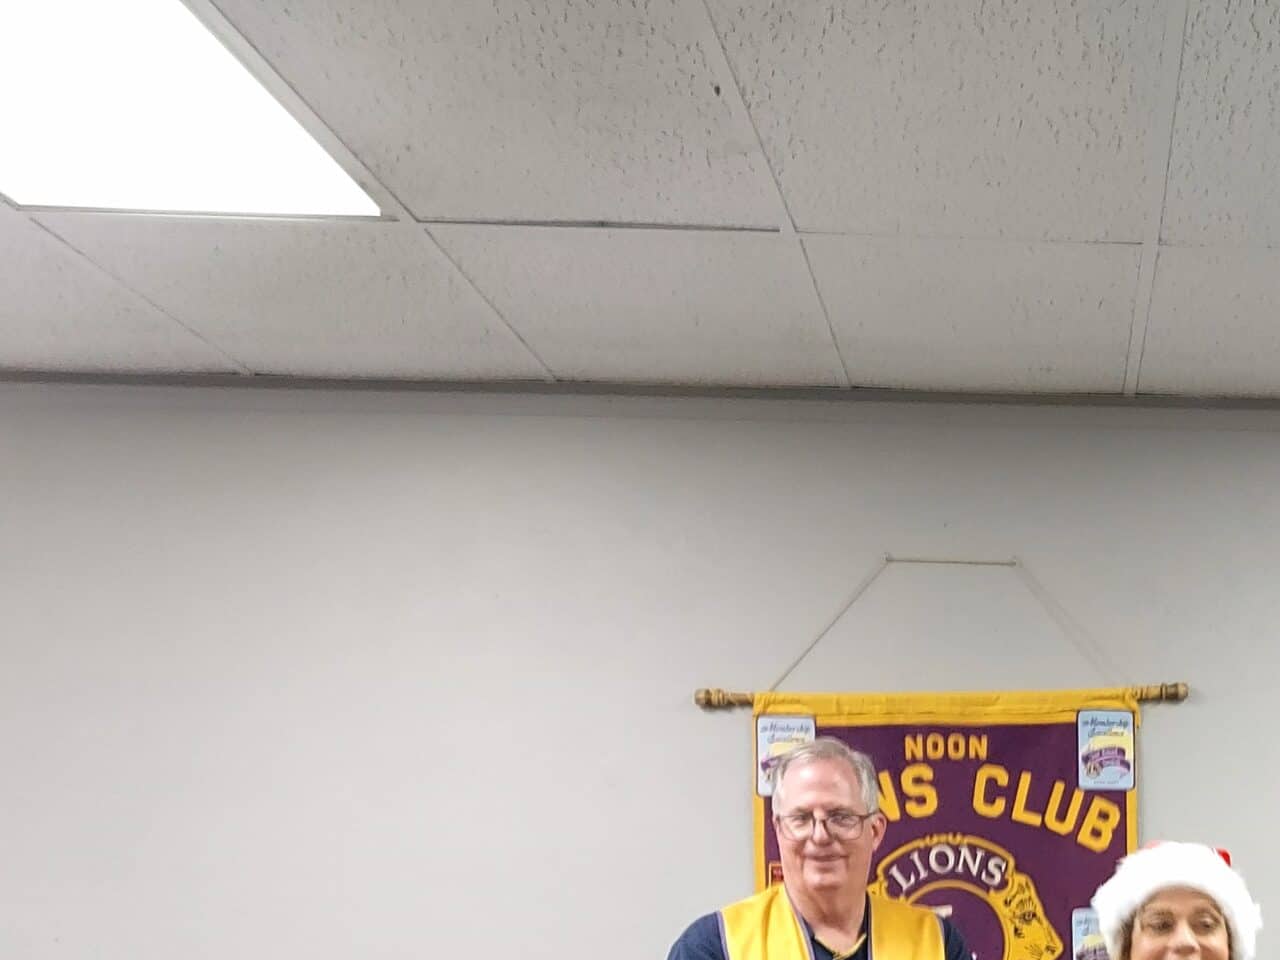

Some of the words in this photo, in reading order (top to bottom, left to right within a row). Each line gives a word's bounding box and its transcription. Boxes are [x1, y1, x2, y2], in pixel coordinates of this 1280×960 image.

[904, 733, 988, 760] NOON
[973, 763, 1121, 852] CLUB
[889, 844, 1007, 892] LIONS
